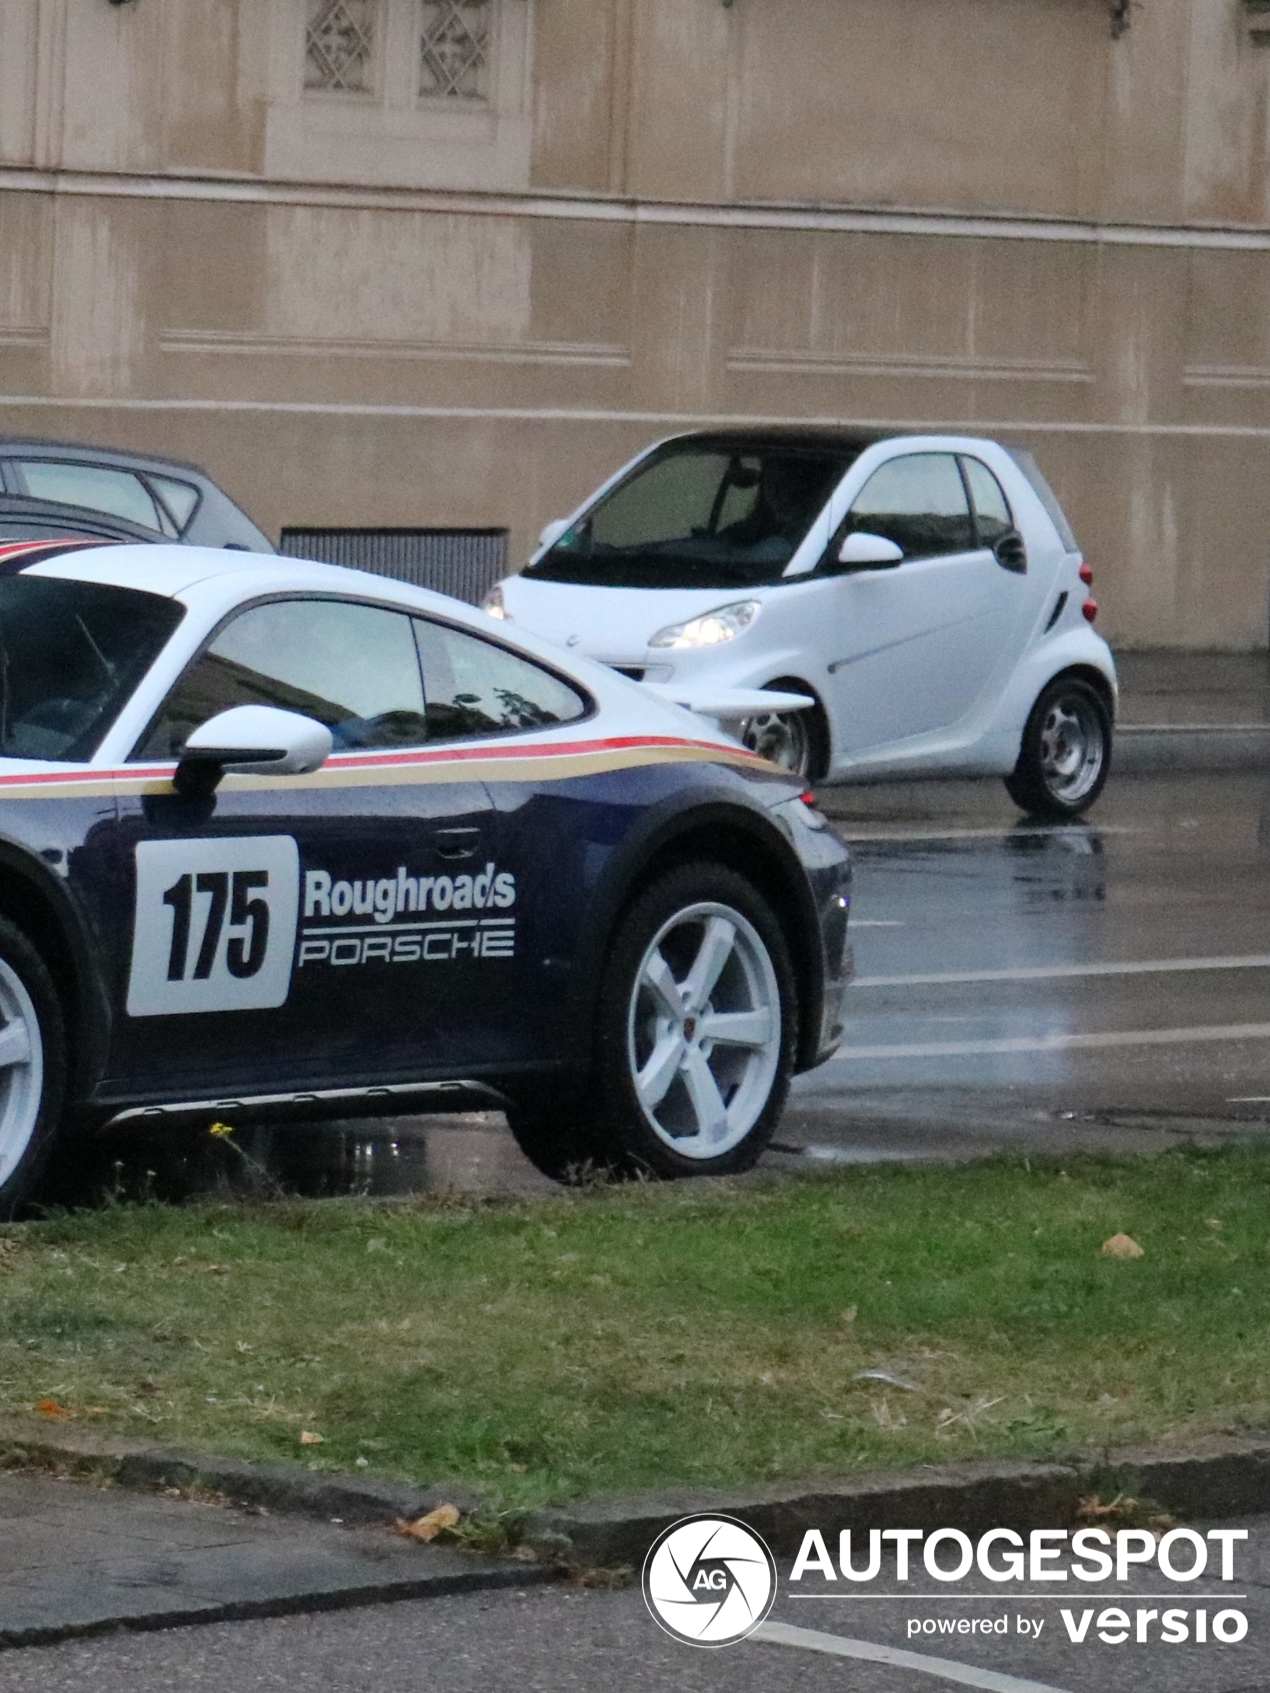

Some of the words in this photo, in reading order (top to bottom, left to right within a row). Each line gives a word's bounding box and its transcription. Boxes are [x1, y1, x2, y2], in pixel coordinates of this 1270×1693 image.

[305, 863, 516, 923] Roughroads
[163, 870, 269, 981] 175
[299, 931, 514, 967] PORSCHE
